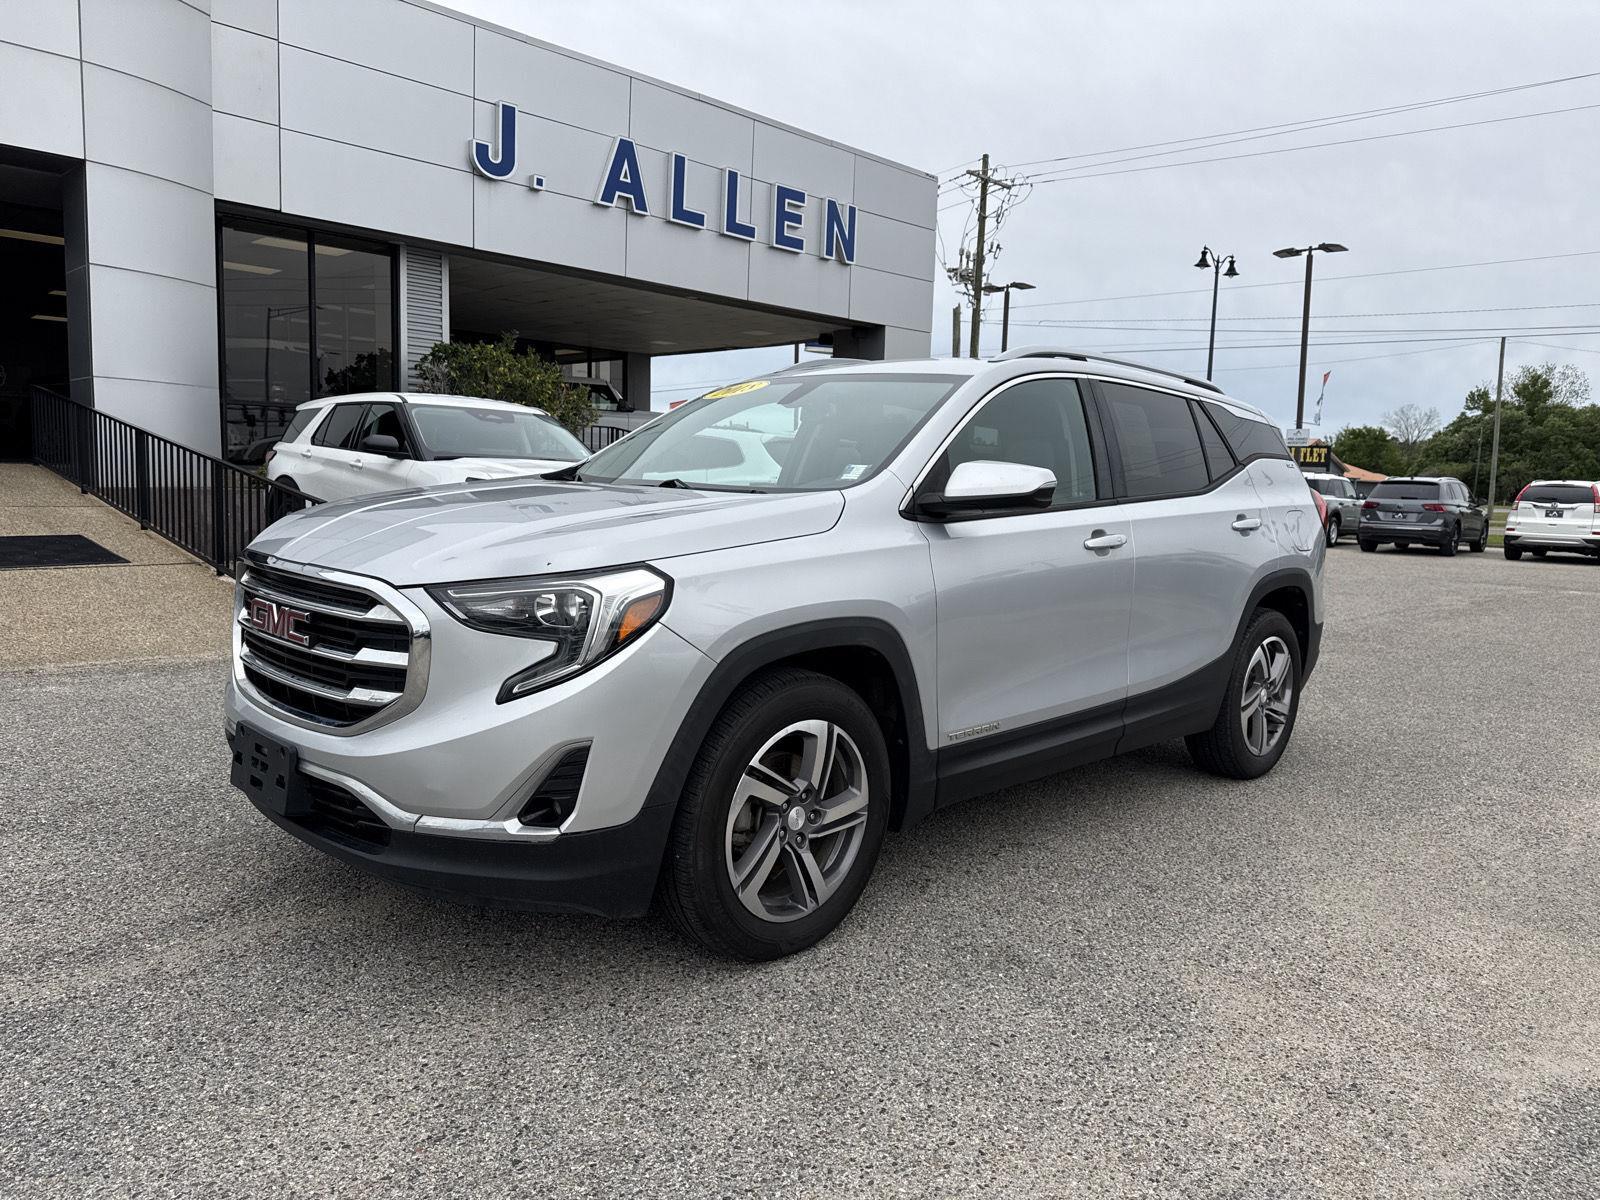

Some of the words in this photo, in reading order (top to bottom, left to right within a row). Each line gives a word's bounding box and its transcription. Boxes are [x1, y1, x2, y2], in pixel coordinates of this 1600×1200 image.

[469, 101, 546, 191] J.
[594, 136, 858, 265] ALLEN
[250, 598, 310, 646] GMC
[947, 722, 1001, 741] TERRAIN
